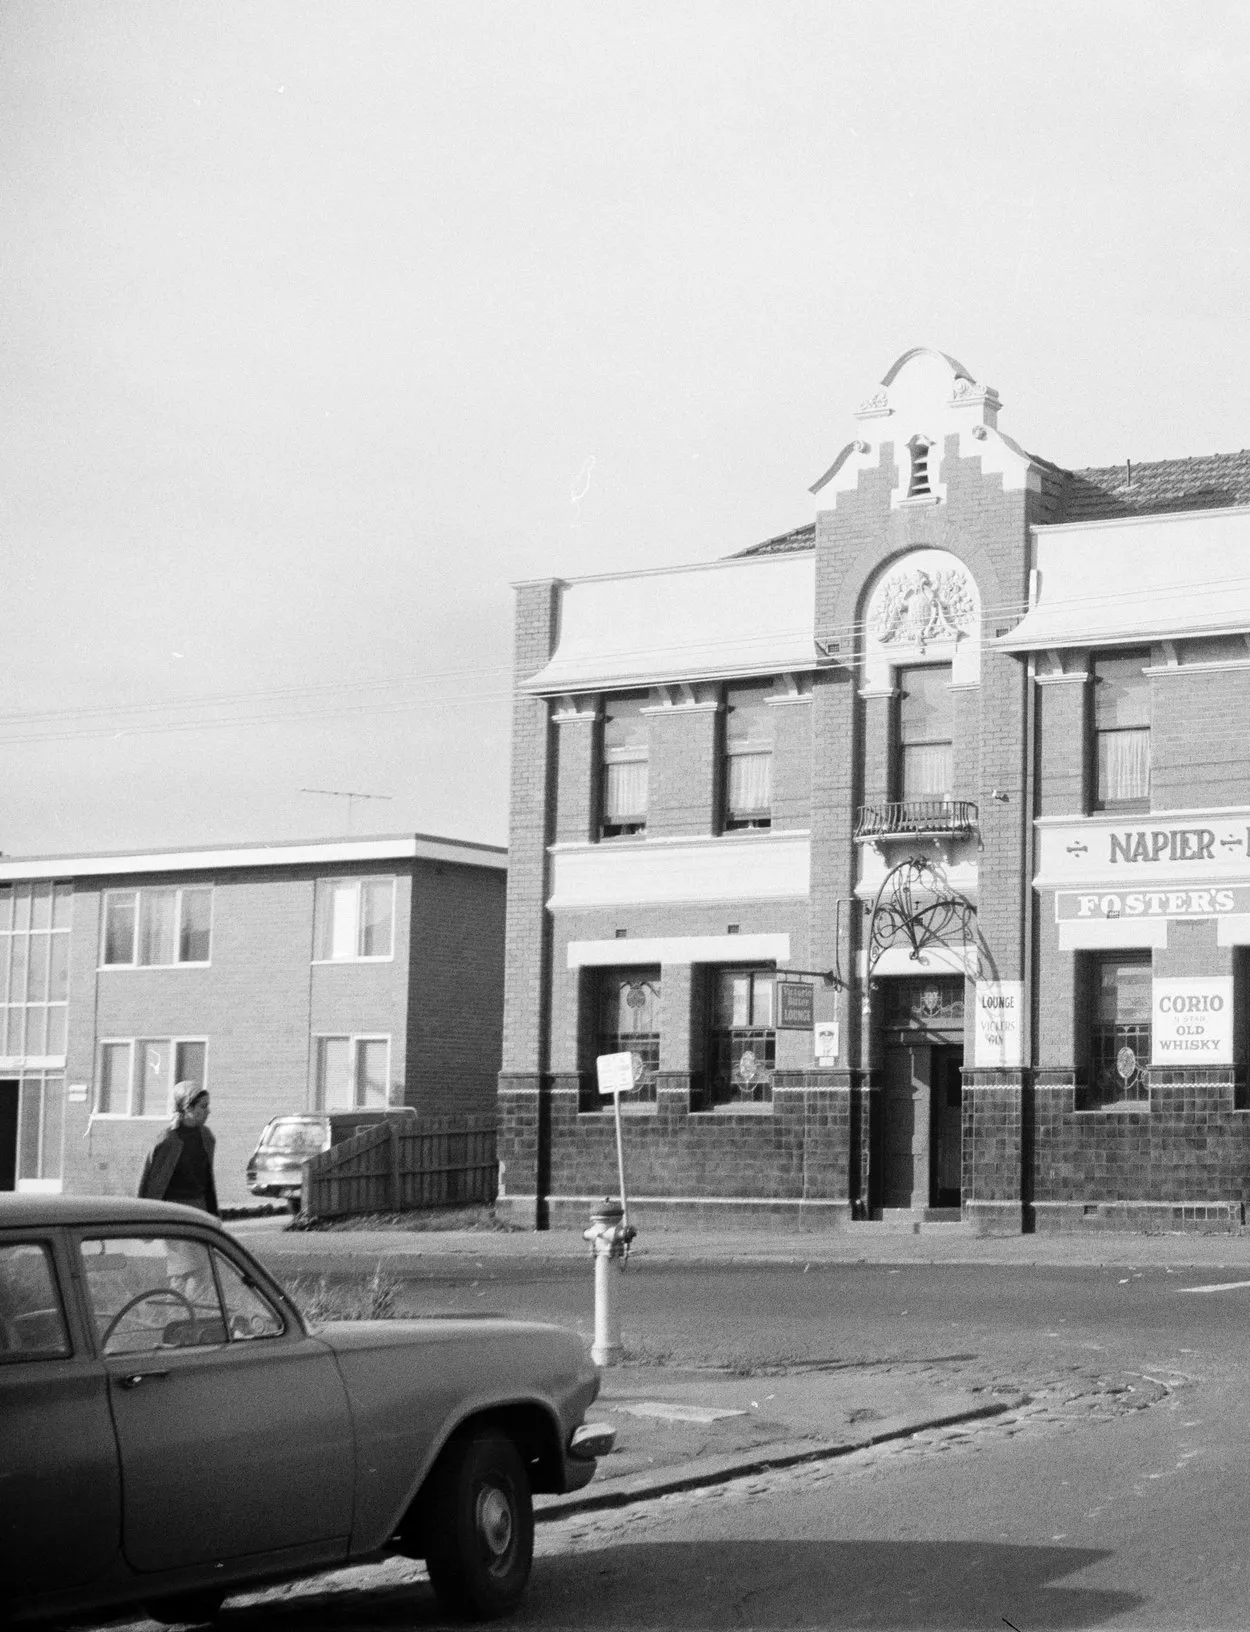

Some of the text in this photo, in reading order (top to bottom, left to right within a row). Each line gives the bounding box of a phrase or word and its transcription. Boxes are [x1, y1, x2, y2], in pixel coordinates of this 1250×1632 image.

[1109, 829, 1216, 864] NAPIER
[1077, 888, 1235, 917] FOSTER'S
[982, 996, 1015, 1009] LOUNGE
[1160, 995, 1224, 1013] CORIO
[1176, 1026, 1205, 1035] OLD
[1160, 1040, 1221, 1051] WHISKY
